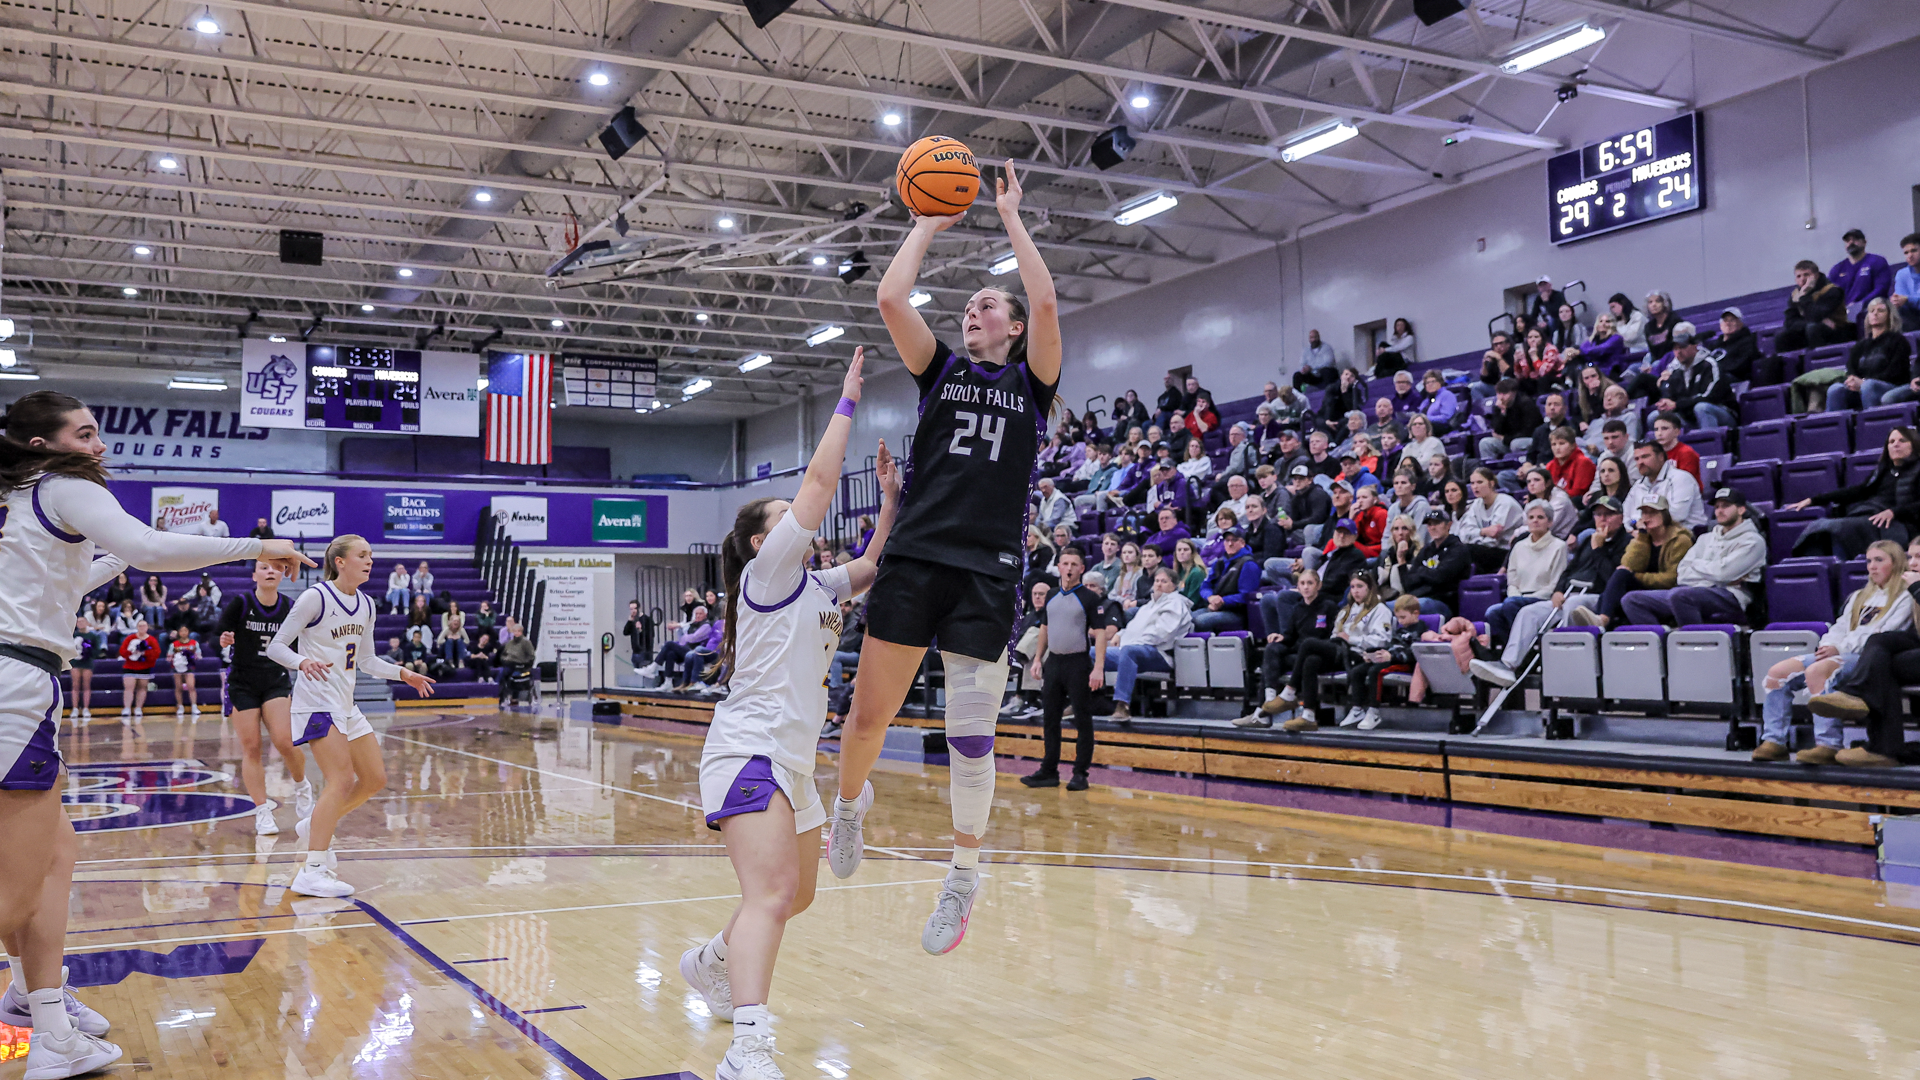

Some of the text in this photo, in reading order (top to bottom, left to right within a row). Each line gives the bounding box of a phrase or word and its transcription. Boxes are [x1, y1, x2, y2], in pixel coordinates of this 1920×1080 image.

[1599, 129, 1652, 172] 6:59
[1632, 152, 1692, 183] MAVERICKS
[1658, 173, 1691, 208] 24
[1613, 193, 1626, 218] 2
[1560, 200, 1590, 235] 29
[312, 366, 348, 378] COUGARS
[374, 370, 419, 382] MAVERICKS
[246, 372, 298, 405] USF
[313, 378, 339, 396] 29
[393, 382, 418, 401] 24
[423, 386, 465, 401] Avera
[345, 398, 384, 408] PLAYER FOUL
[941, 383, 1024, 413] SIOUX FALLS
[250, 407, 294, 417] COUGARS
[949, 411, 1006, 461] 24
[113, 442, 222, 459] OUGARS
[159, 501, 212, 518] Prairie
[276, 503, 330, 525] Culver's
[598, 514, 632, 527] Avera
[246, 620, 266, 631] SIOUX
[345, 643, 356, 671] 2
